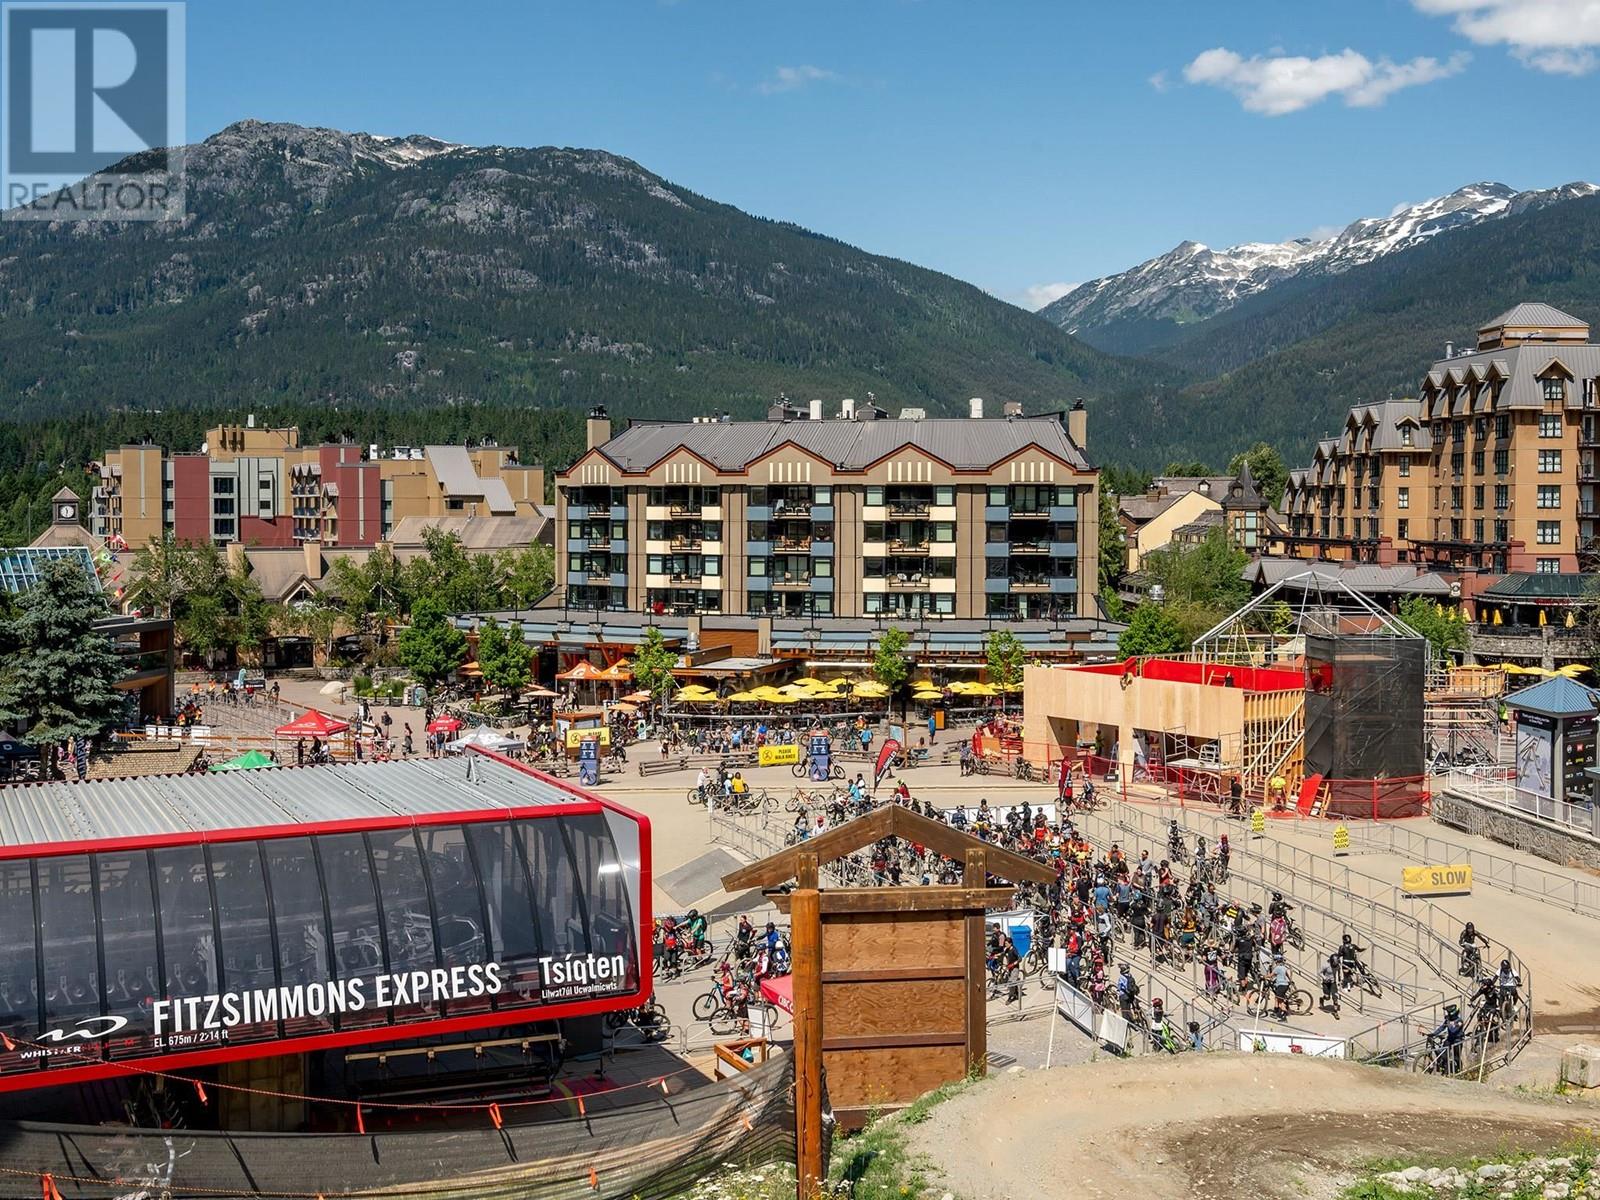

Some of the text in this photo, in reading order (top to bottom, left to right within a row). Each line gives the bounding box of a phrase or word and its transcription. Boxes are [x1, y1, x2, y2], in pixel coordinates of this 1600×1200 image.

[1431, 870, 1467, 886] SLOW
[538, 952, 625, 985] Tsíqten
[153, 962, 502, 1035] FITZSIMMONS EXPRESS
[168, 1034, 192, 1046] 675m
[221, 1029, 229, 1039] ft
